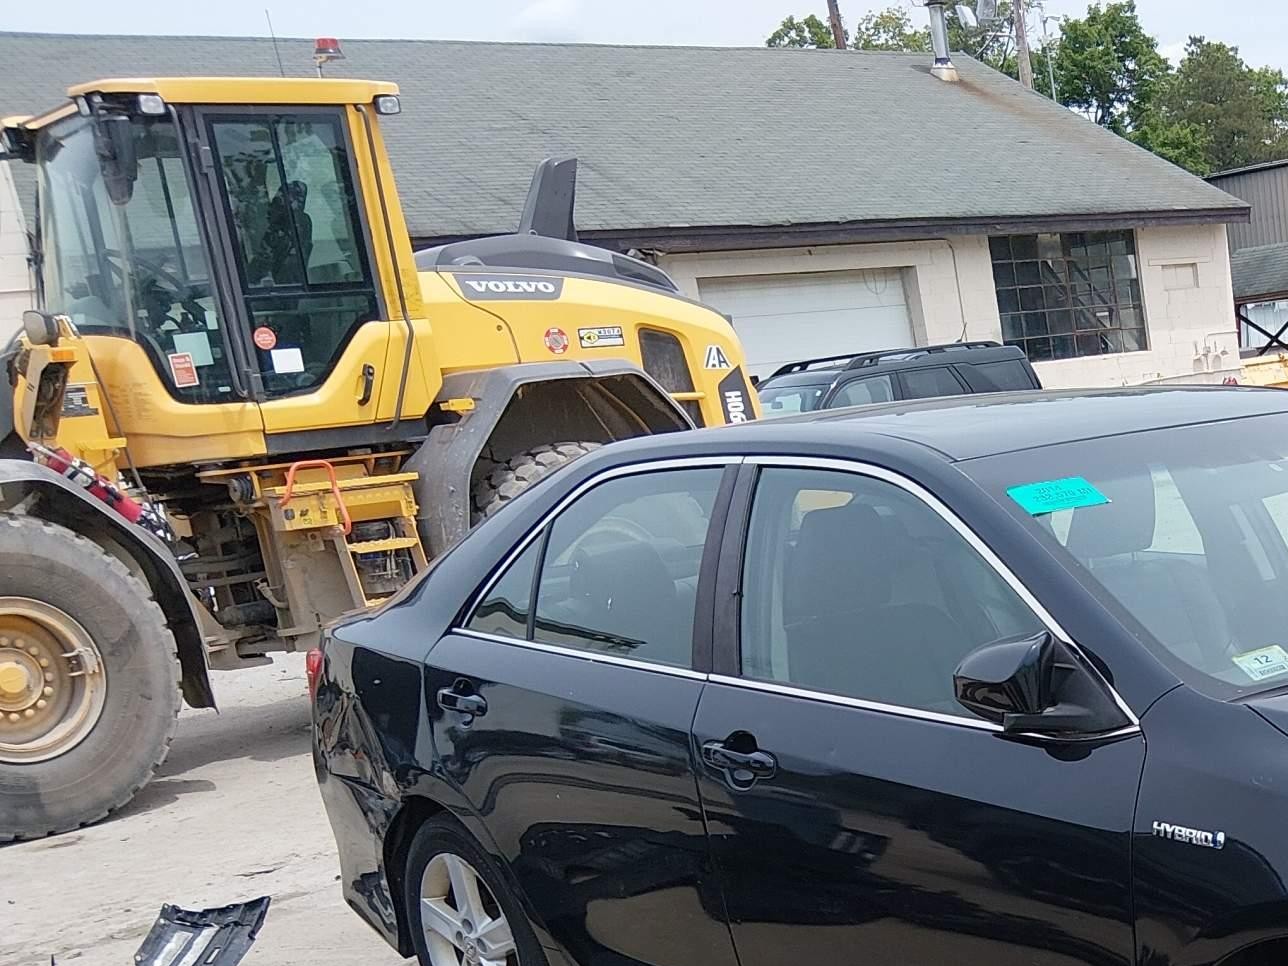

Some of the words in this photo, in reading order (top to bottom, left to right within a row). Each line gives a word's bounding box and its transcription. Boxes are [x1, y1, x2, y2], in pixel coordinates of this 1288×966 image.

[465, 281, 555, 292] VOLVO
[1253, 654, 1273, 665] 12
[1152, 820, 1214, 848] HYBRID
